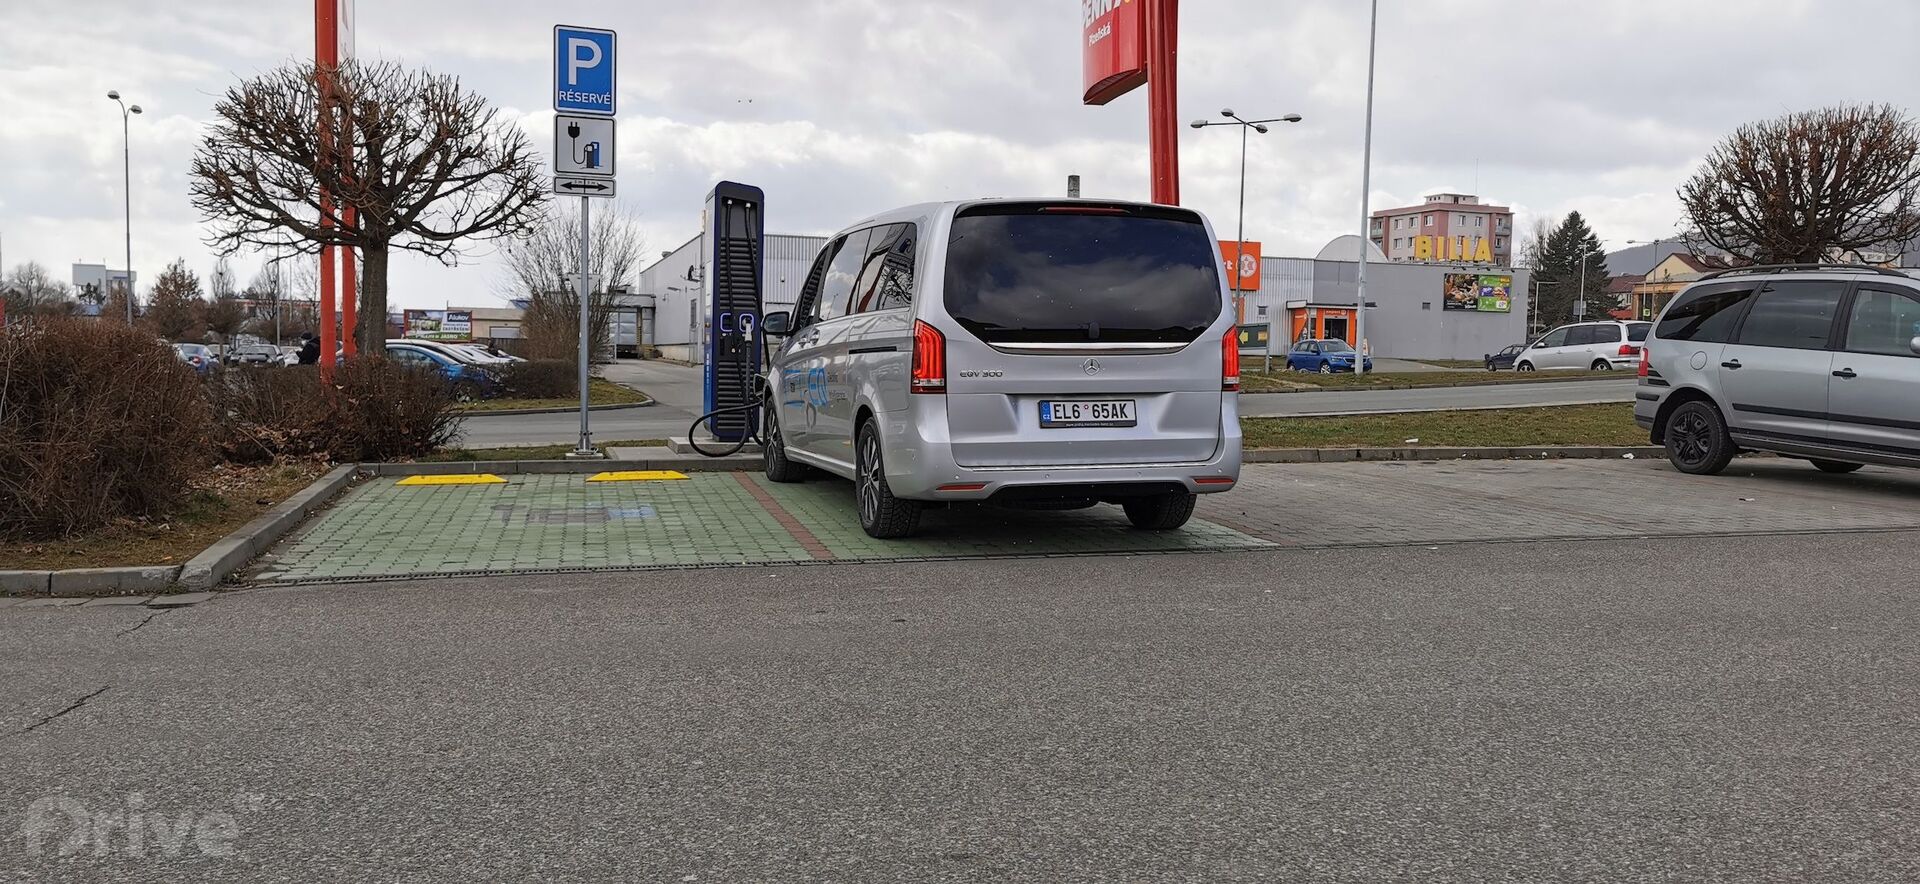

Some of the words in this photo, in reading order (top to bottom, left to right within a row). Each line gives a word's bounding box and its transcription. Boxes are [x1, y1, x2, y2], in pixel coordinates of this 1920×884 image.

[568, 37, 602, 85] P
[559, 89, 611, 104] RÉSERVÉ
[1415, 235, 1492, 262] BILLA
[1053, 404, 1080, 420] EL6
[1092, 403, 1128, 419] 65AK
